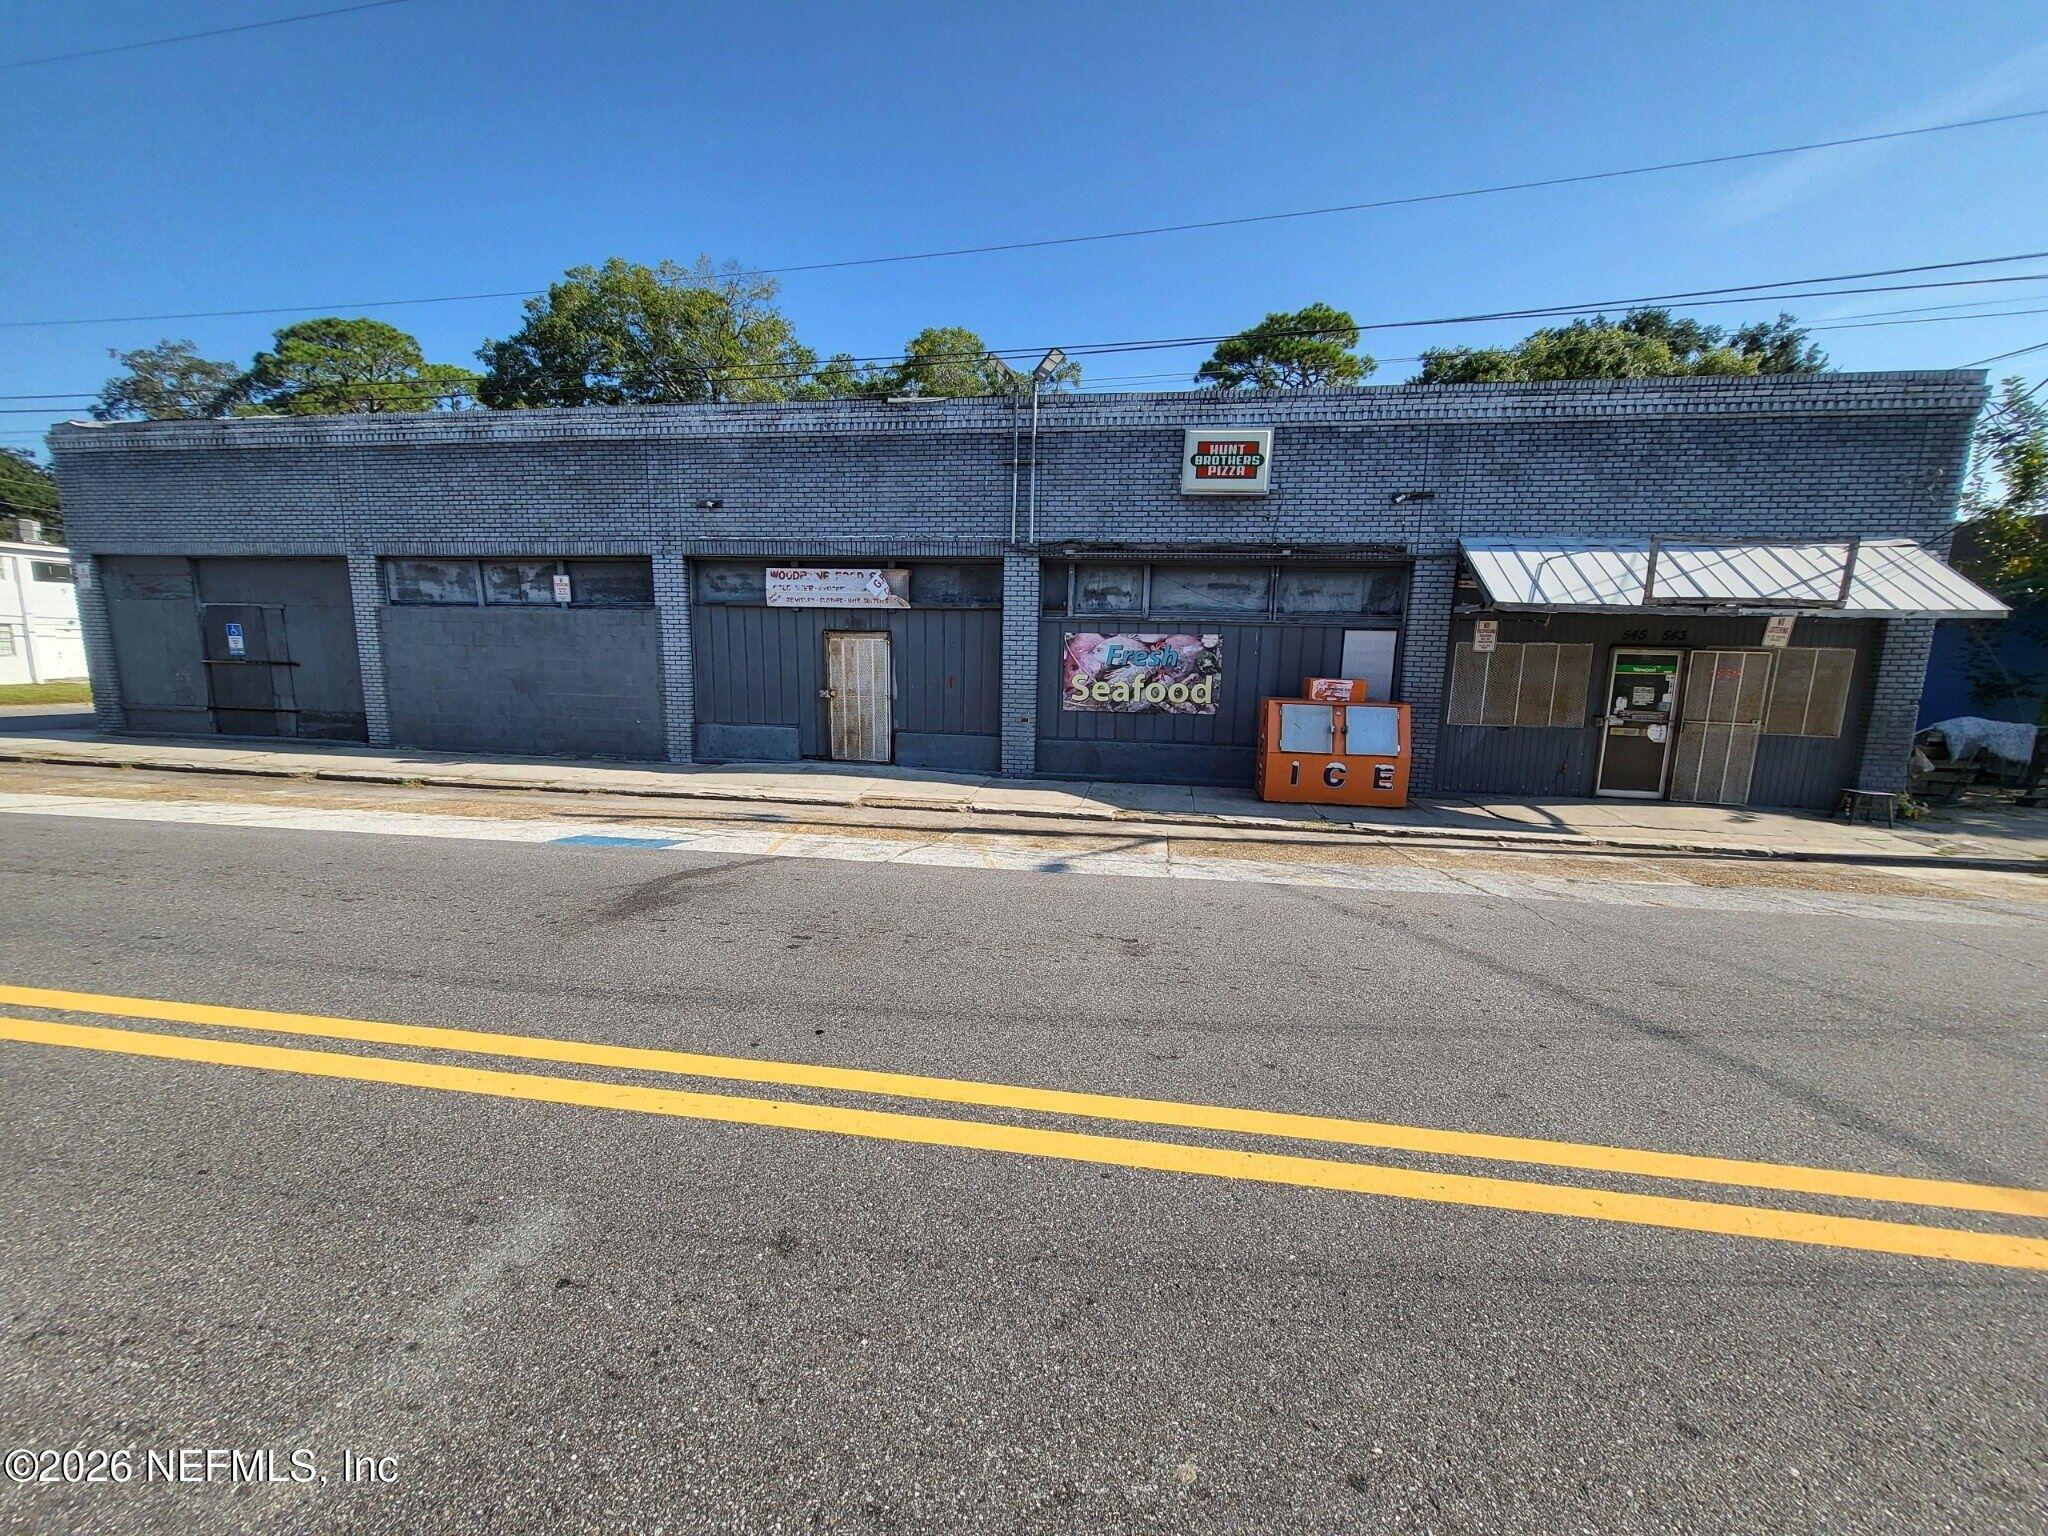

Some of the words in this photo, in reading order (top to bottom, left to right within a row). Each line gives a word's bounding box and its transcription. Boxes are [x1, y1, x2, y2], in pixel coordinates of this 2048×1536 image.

[1209, 444, 1246, 455] HUNT
[1194, 455, 1261, 466] BROTHERS
[1207, 465, 1246, 476] PIZZA
[1105, 644, 1179, 668] Fresh
[1070, 673, 1213, 705] Seafood
[1290, 760, 1395, 791] ICE
